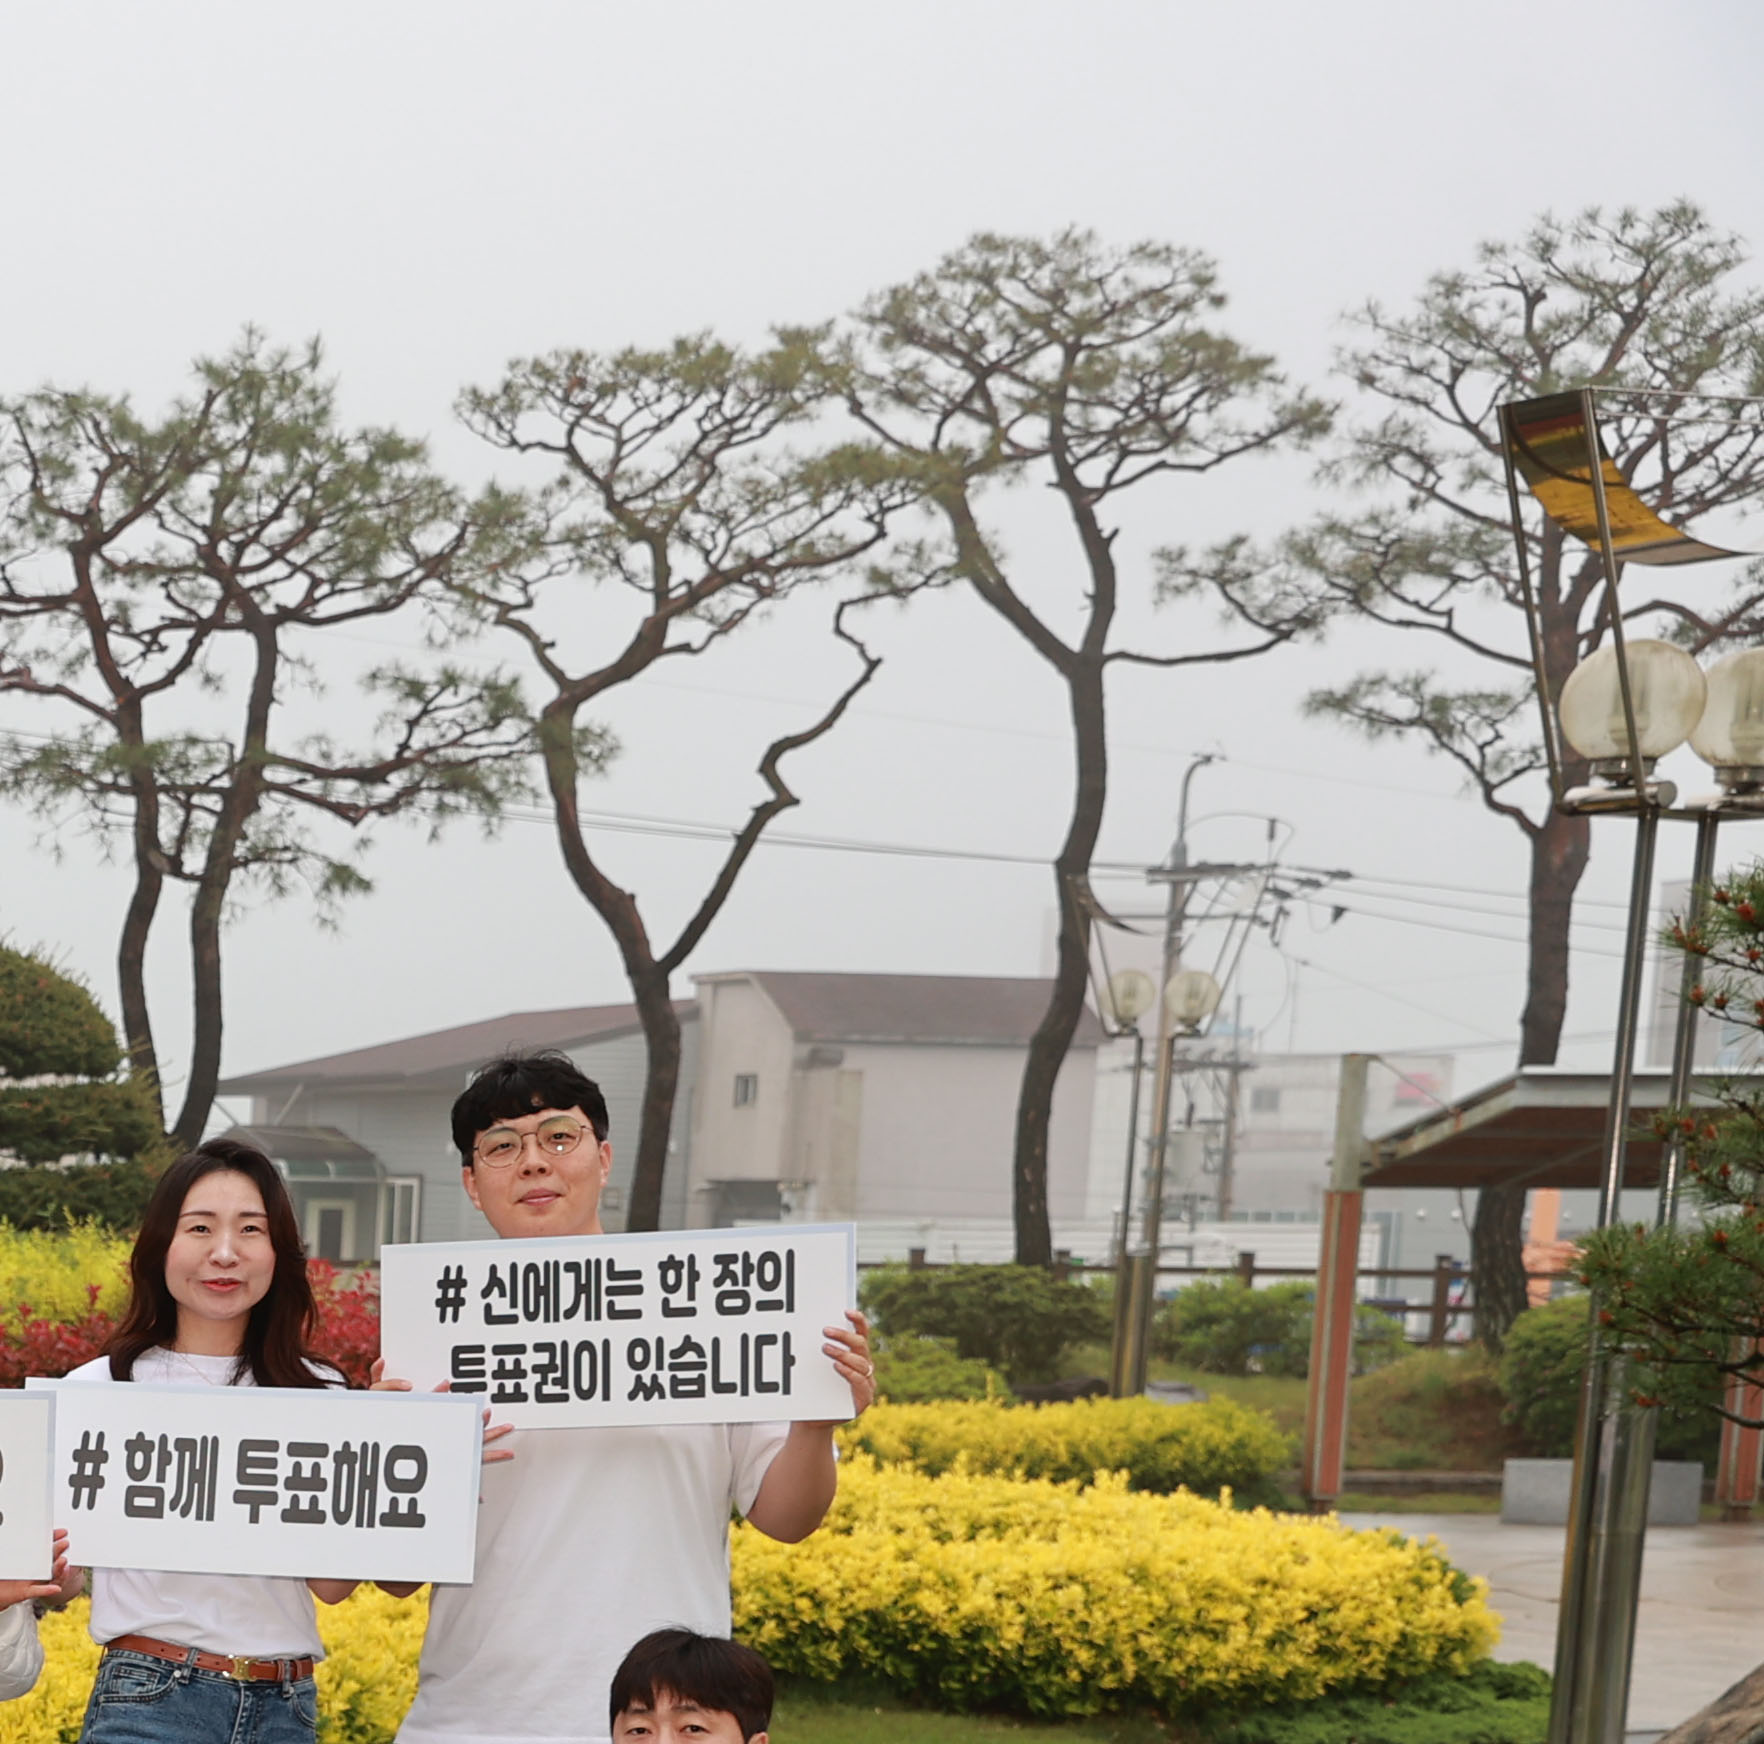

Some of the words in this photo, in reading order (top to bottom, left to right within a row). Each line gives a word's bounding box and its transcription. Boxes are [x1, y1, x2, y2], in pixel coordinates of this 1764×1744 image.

[435, 1265, 468, 1323] #
[480, 1258, 643, 1326] 신에게는
[657, 1254, 701, 1318] 한
[713, 1249, 795, 1315] 장의
[449, 1339, 611, 1404] 투표권이
[627, 1332, 796, 1402] 있습니다
[68, 1430, 109, 1511] #
[124, 1431, 219, 1522] 함께
[232, 1439, 428, 1529] 투표해요
